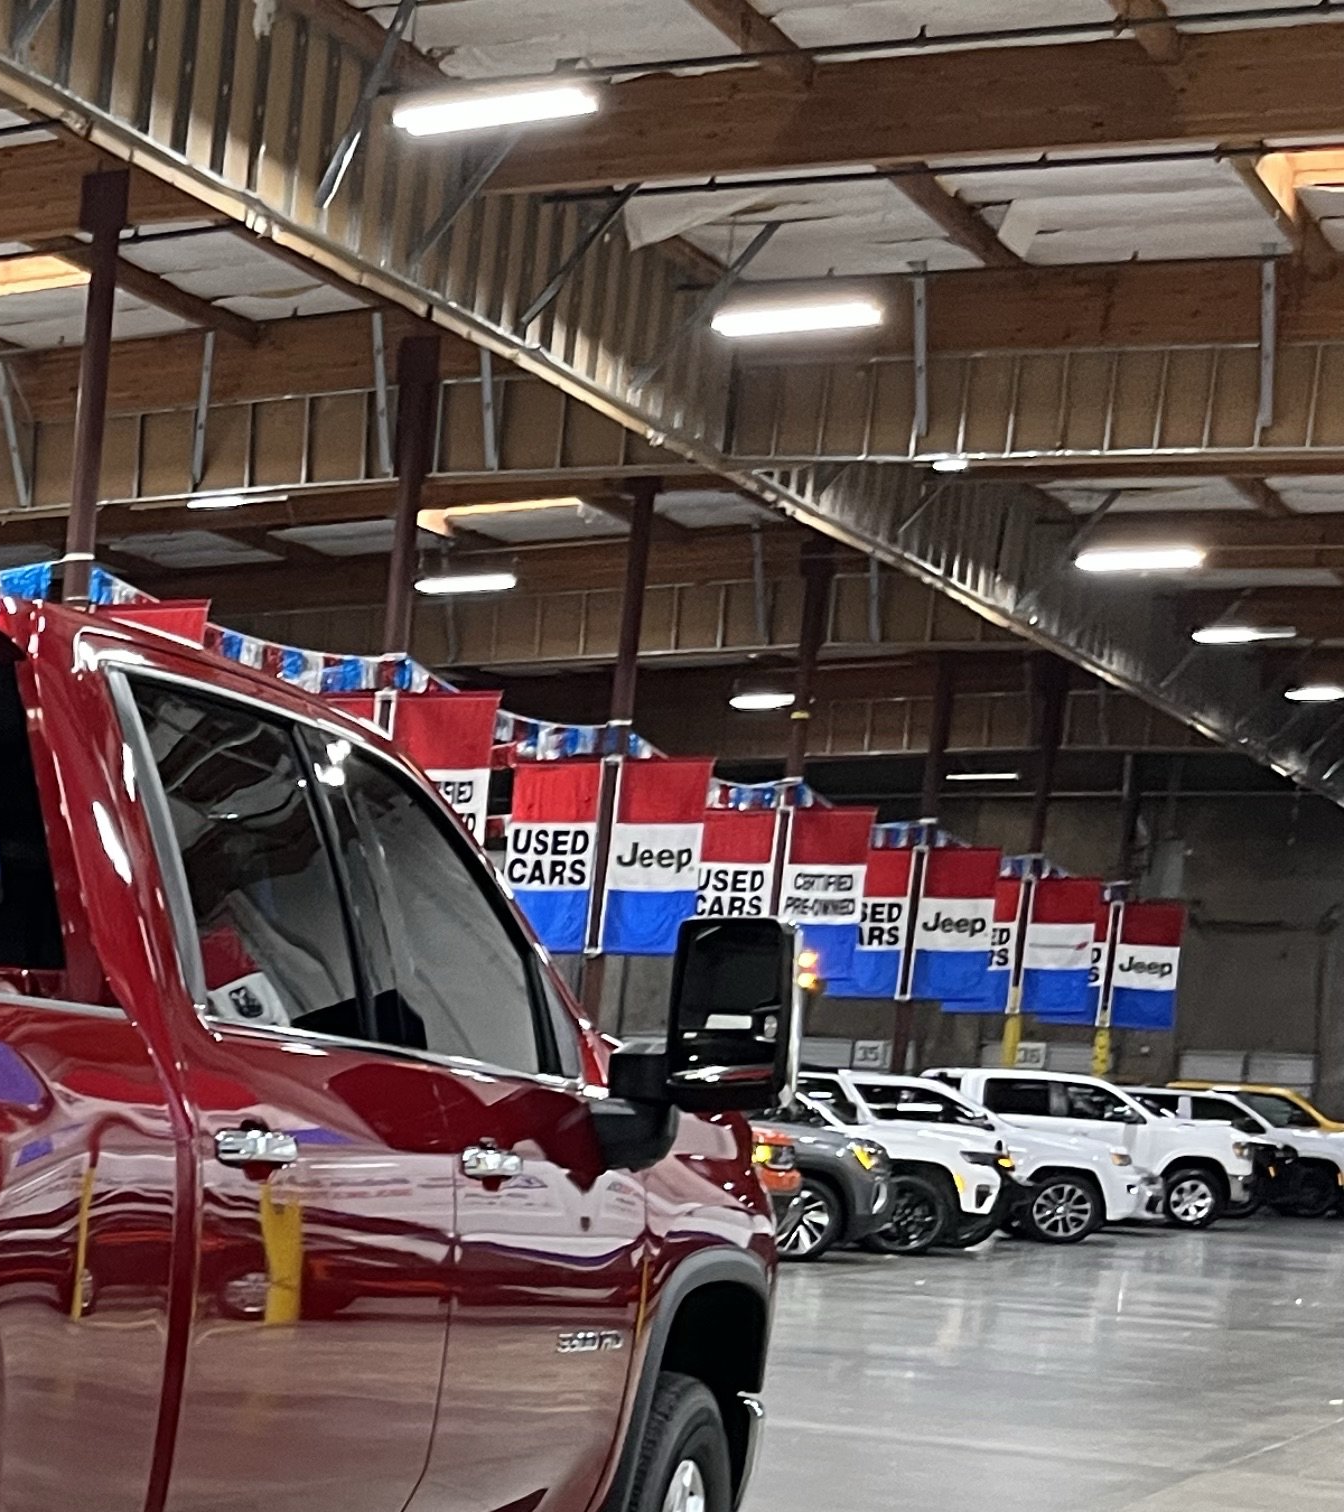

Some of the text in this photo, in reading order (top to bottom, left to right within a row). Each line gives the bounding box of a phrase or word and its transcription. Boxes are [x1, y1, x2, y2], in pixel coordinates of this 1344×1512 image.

[513, 828, 589, 856] USED
[616, 841, 693, 873] Jeep
[508, 858, 587, 885] CARS
[698, 869, 765, 893] USED
[695, 896, 763, 917] CARS
[922, 911, 987, 937] Jeep
[1119, 956, 1173, 977] Jeep
